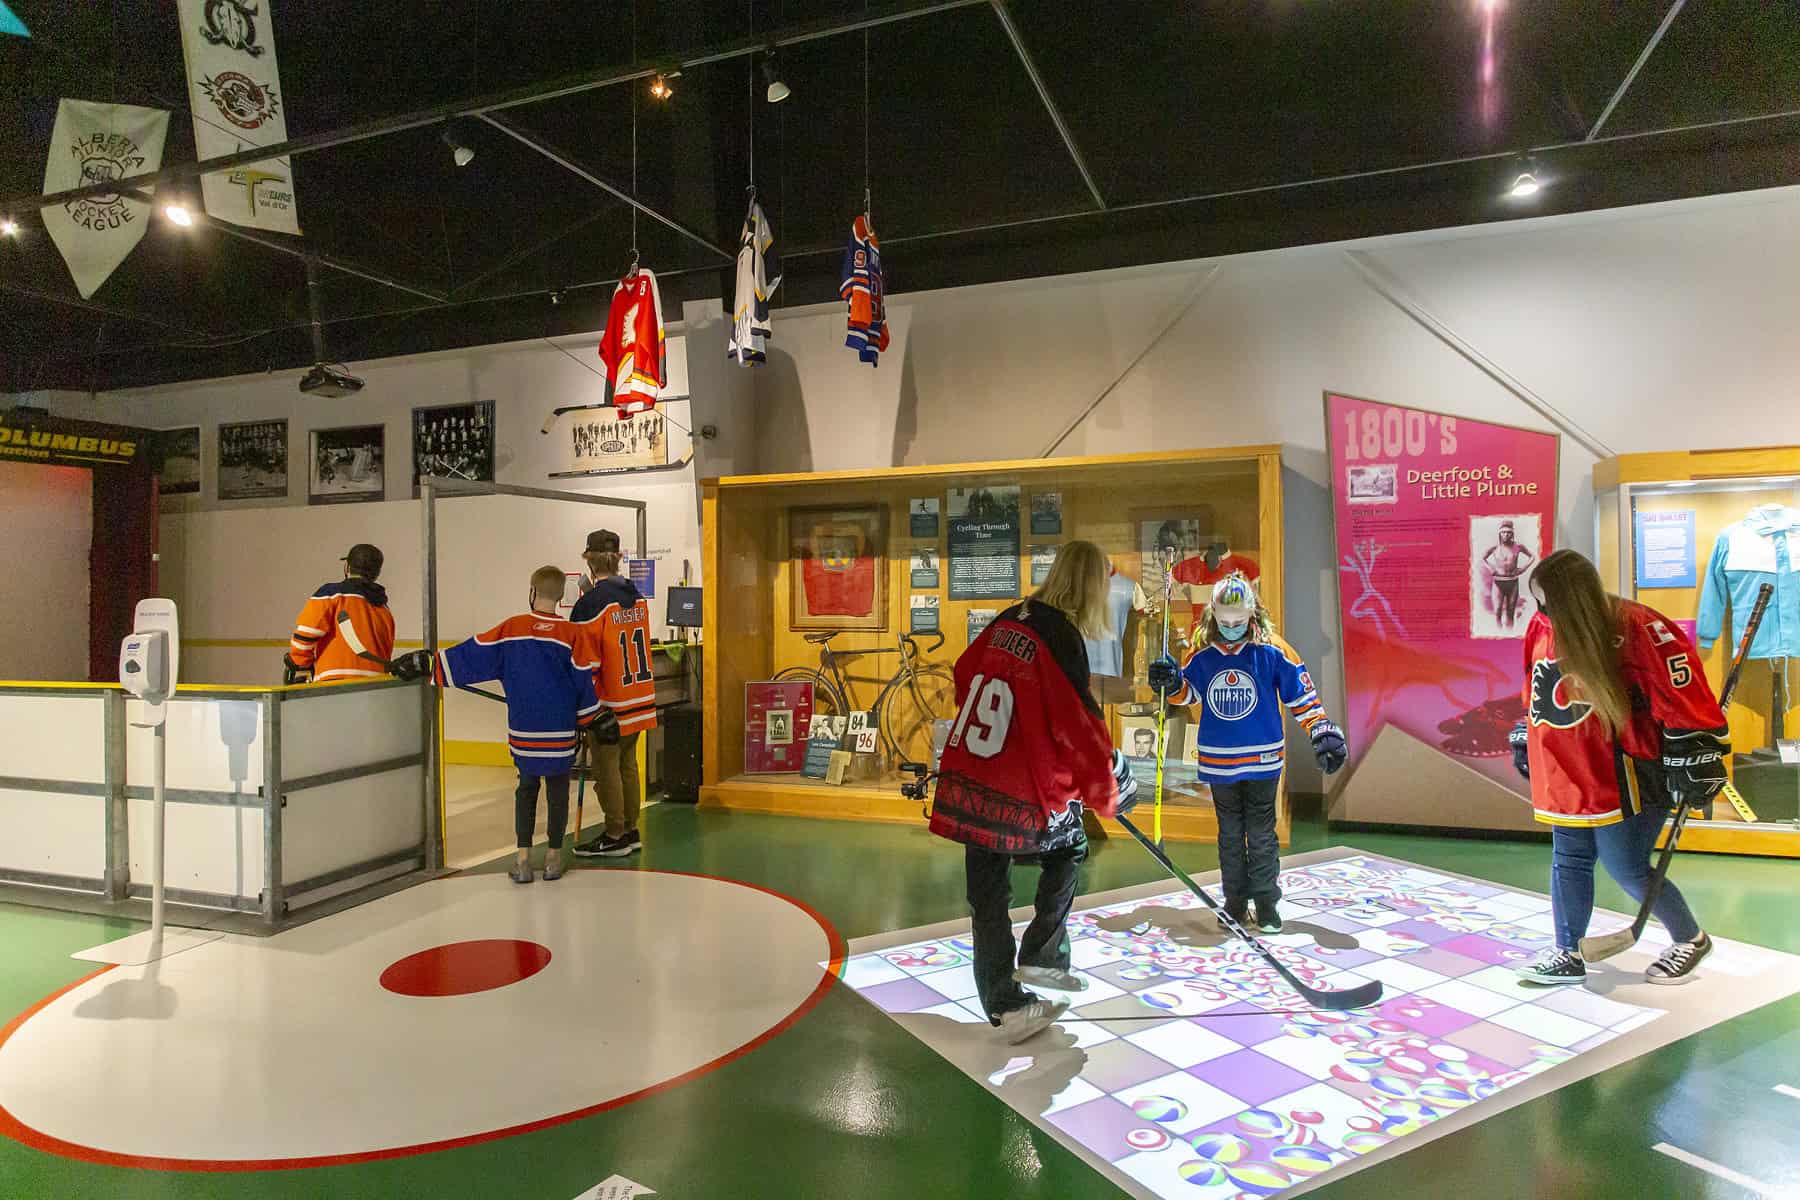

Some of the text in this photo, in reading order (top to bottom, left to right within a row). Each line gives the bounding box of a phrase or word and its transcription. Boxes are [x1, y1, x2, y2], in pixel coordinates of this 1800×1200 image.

[71, 133, 145, 168] ALBERTA
[64, 200, 136, 231] LEAGUE
[79, 199, 125, 217] OCKEY
[1345, 409, 1457, 460] 1800's
[1407, 464, 1513, 483] Deerfoot &
[1422, 480, 1538, 500] Little Plume
[956, 522, 1010, 533] Cycling Through
[619, 627, 653, 687] 11
[1667, 653, 1691, 688] 5
[1214, 687, 1253, 707] OILERS
[851, 714, 864, 730] 84
[950, 674, 1014, 758] 19
[858, 733, 873, 748] 96
